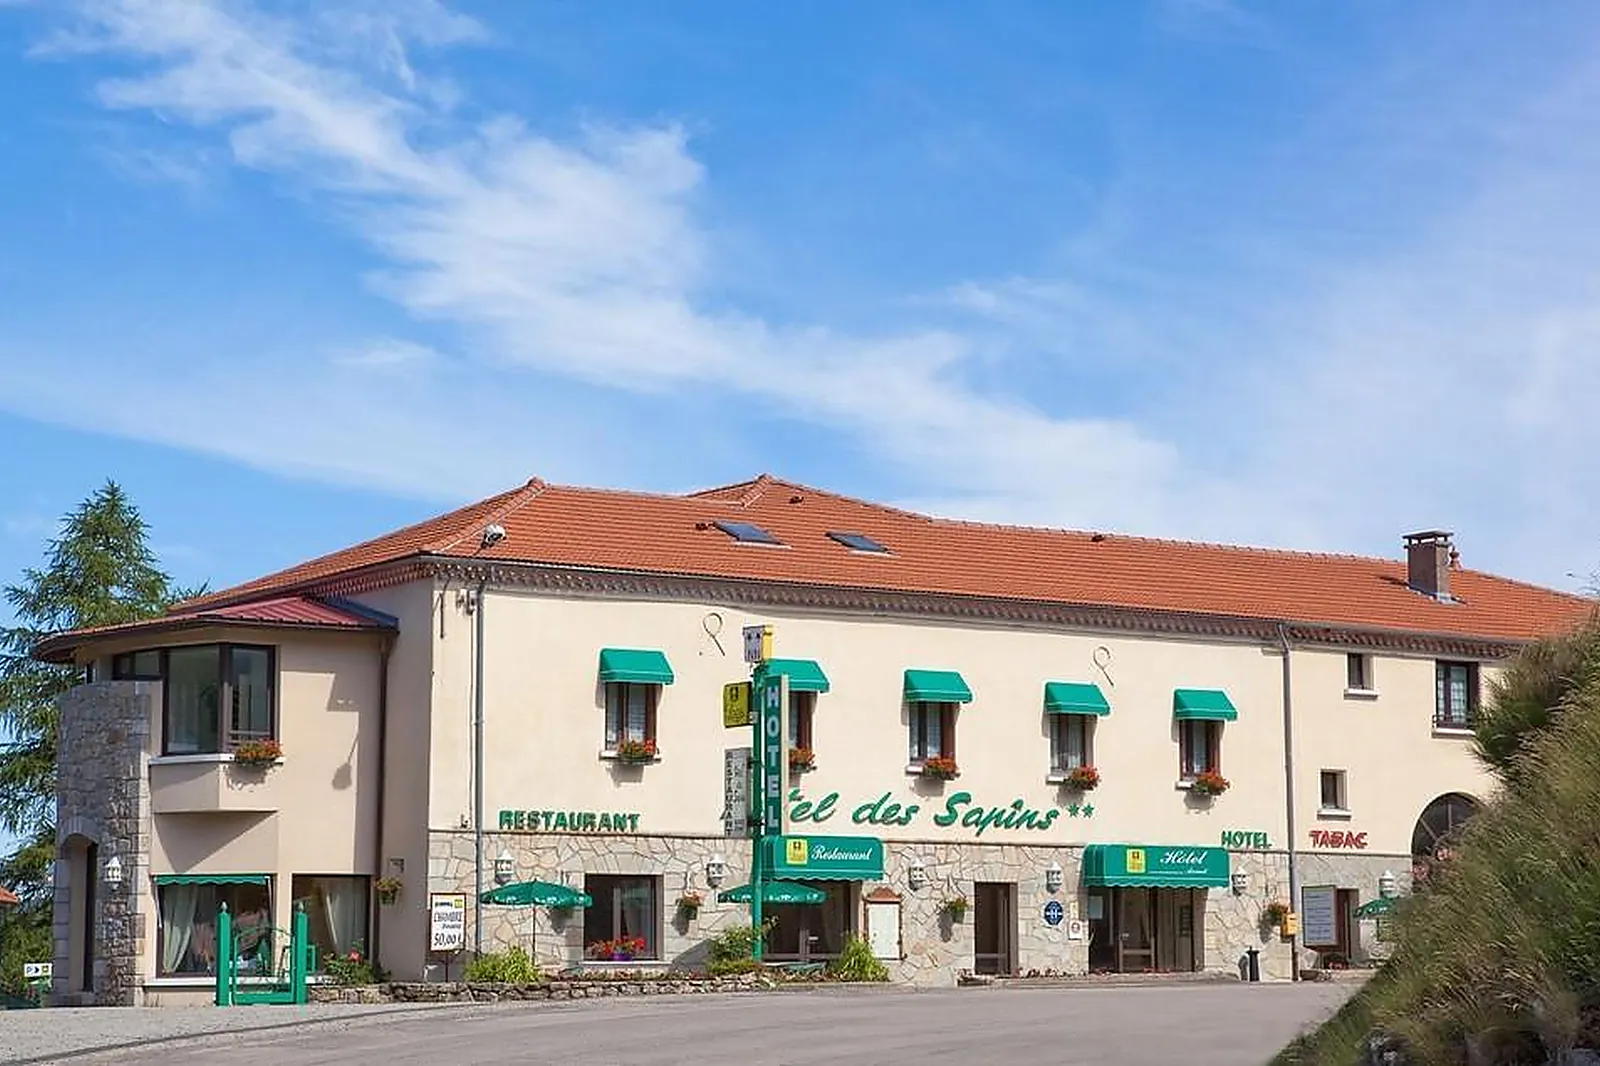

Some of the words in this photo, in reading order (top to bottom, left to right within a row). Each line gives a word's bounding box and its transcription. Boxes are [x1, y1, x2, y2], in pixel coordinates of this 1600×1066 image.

[766, 685, 780, 828] HOTEL
[725, 752, 734, 836] RESTAURANT
[852, 792, 919, 825] des
[498, 810, 641, 832] RESTAURANT
[1221, 830, 1272, 848] HOTEL
[1309, 830, 1368, 849] TABAC
[811, 844, 873, 861] Restaurant
